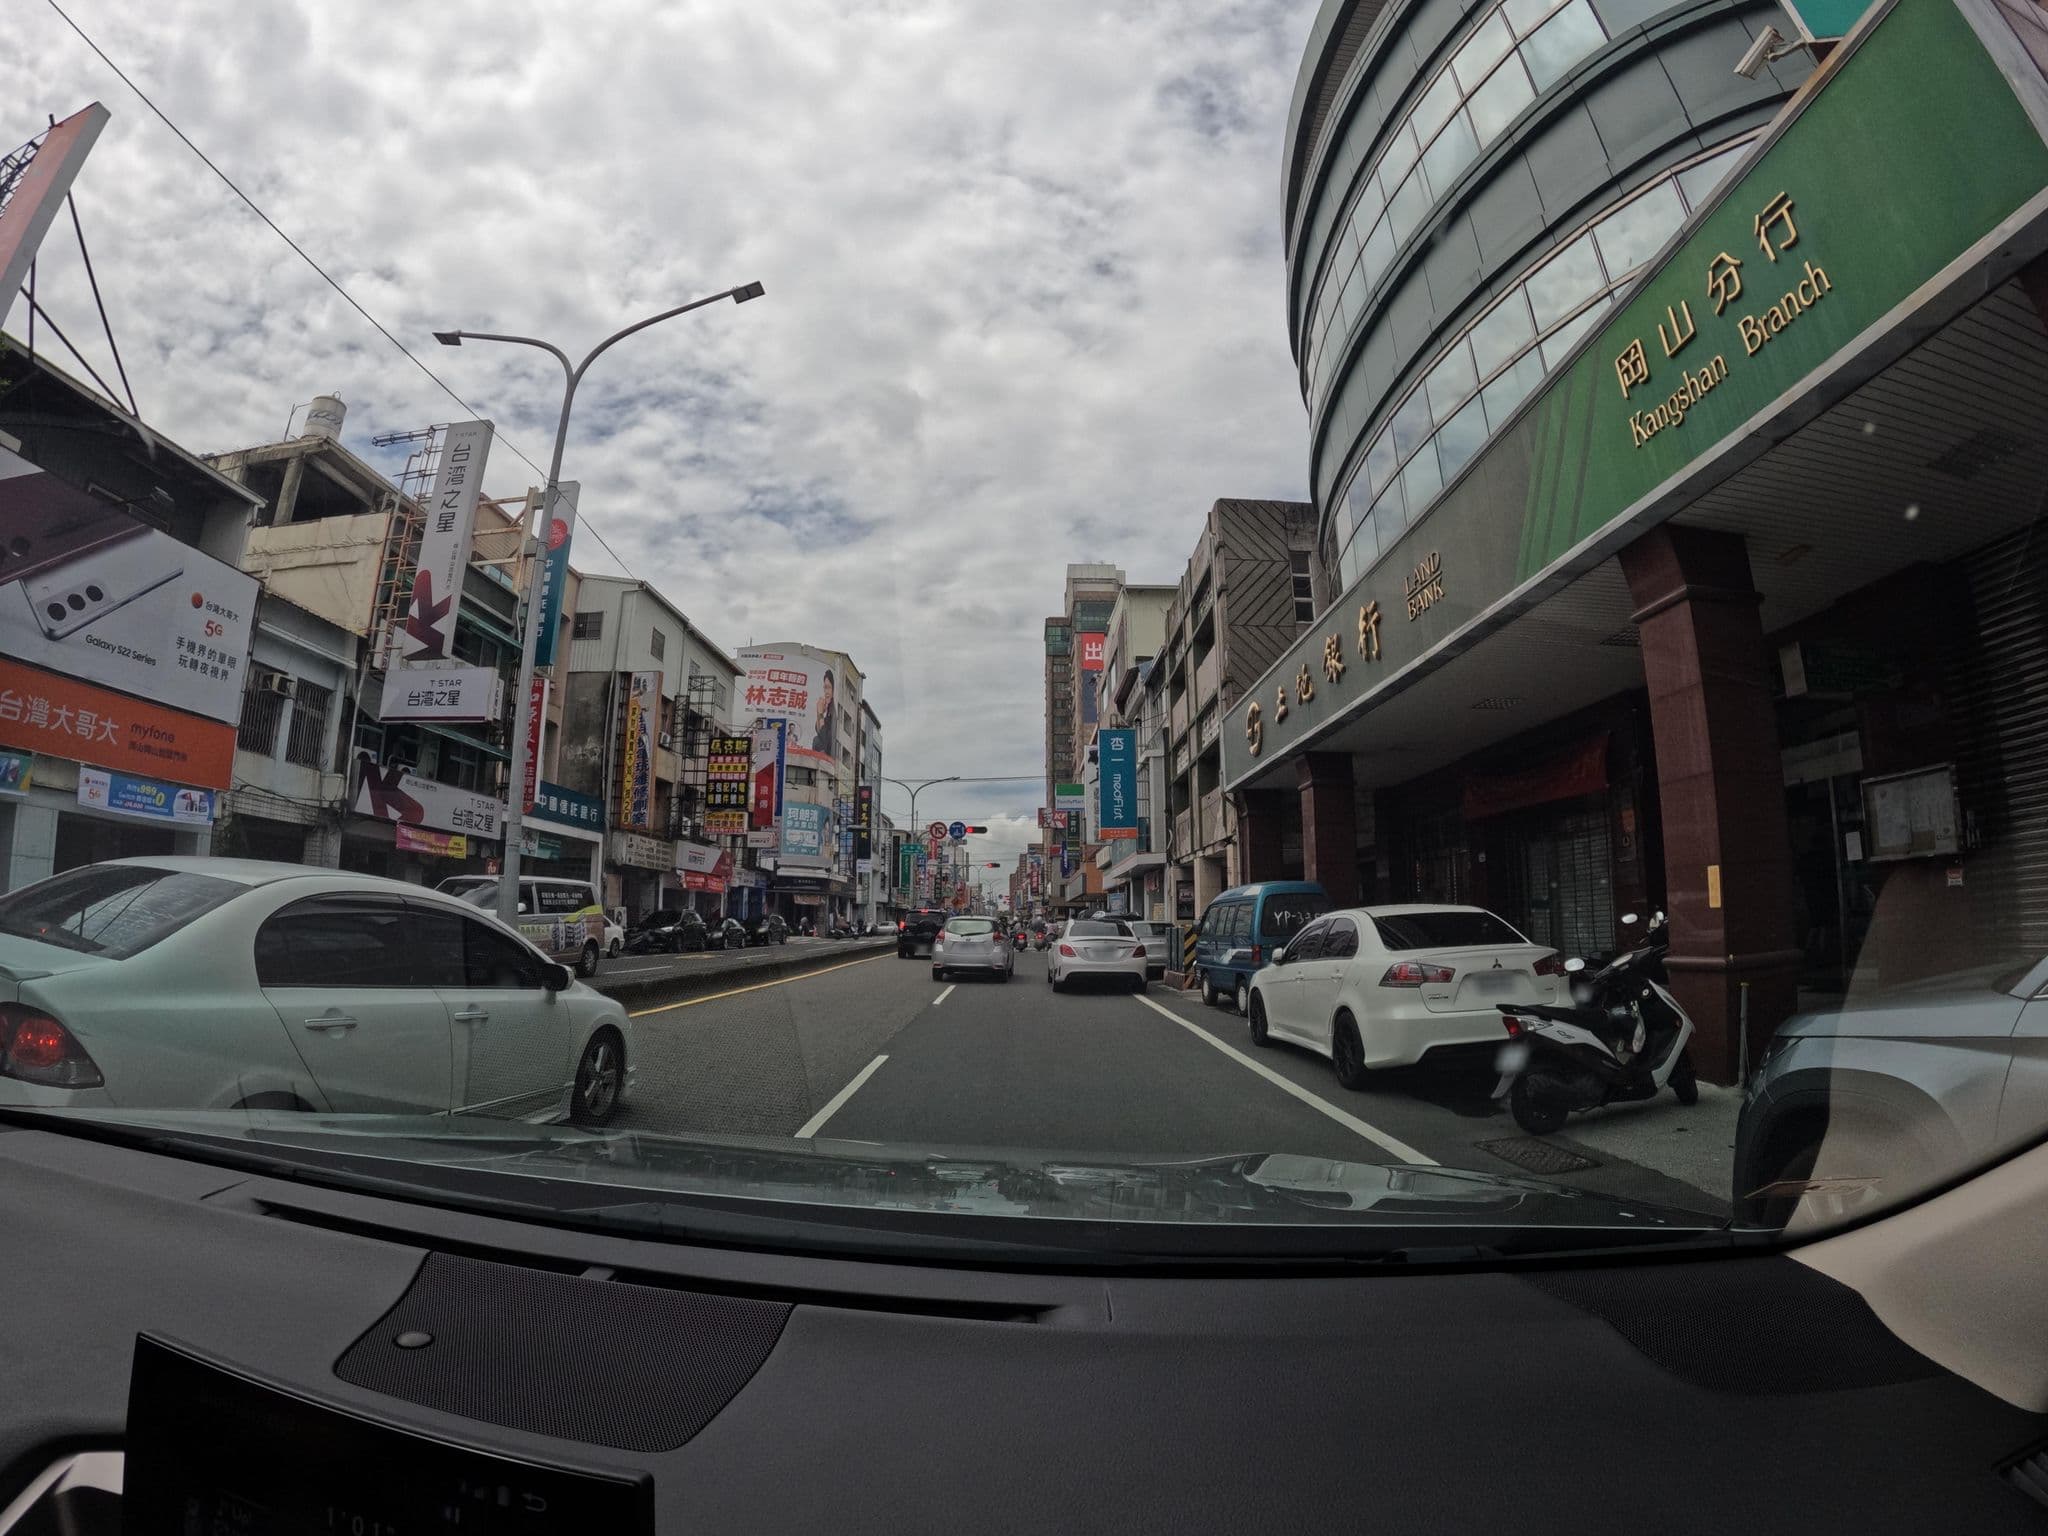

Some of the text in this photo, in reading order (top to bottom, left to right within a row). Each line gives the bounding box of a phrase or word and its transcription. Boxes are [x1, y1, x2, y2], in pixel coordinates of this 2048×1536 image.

[1615, 191, 1798, 400] 岡山分行
[1629, 260, 1833, 449] Kangshan Branch
[1404, 551, 1442, 595] LAND
[1407, 578, 1446, 622] BANK
[204, 619, 223, 637] 5G
[86, 634, 156, 666] Galaxy S22 Series
[176, 636, 237, 670] 手機界的單眼
[1085, 642, 1102, 660] 出
[178, 654, 229, 681] 玩轉夜視界
[745, 685, 808, 709] 林志誠
[0, 690, 118, 744] 台灣大哥大
[130, 722, 176, 743] myfone
[1110, 736, 1125, 762] 杏一
[539, 794, 599, 822] 中國信託銀行
